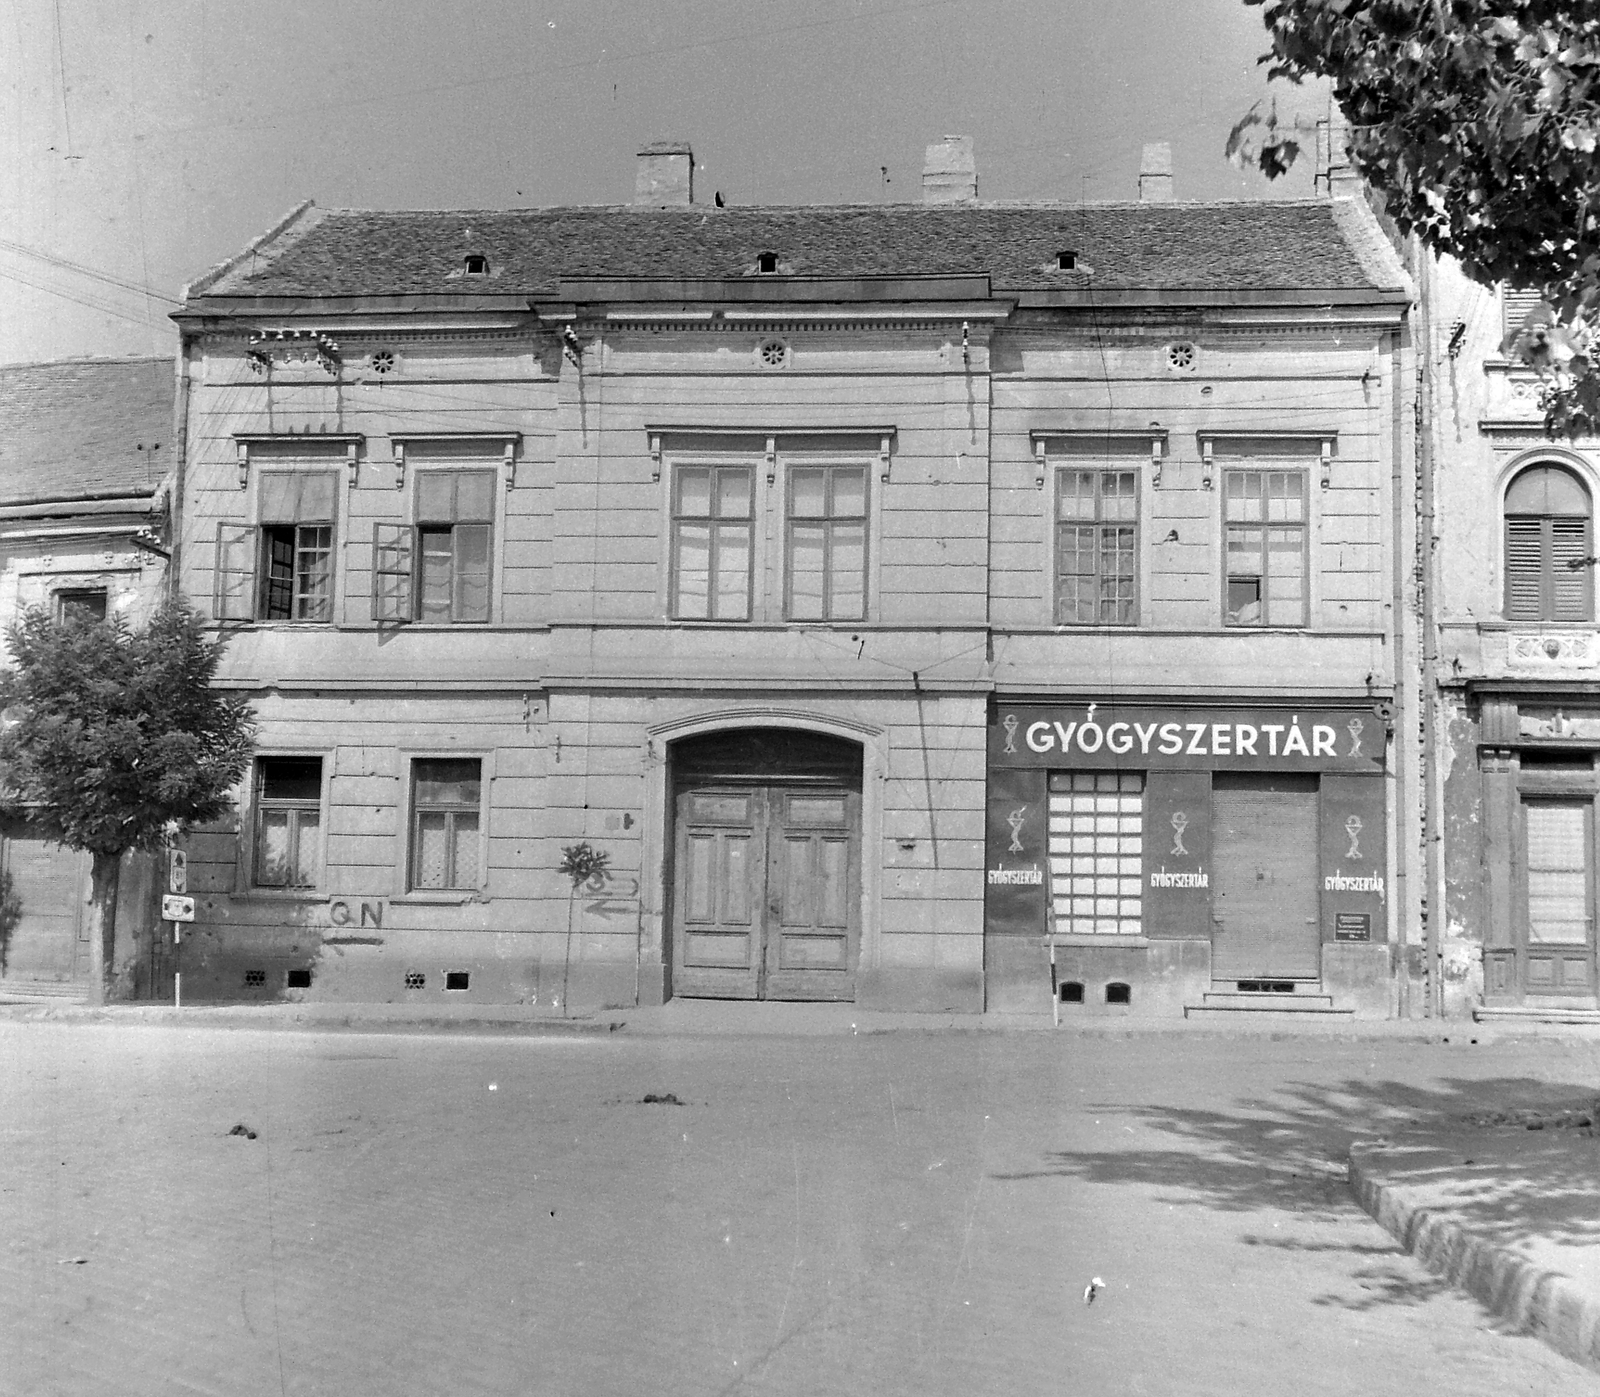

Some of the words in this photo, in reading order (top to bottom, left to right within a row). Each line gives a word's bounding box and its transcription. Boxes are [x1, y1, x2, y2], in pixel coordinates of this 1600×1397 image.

[1026, 713, 1337, 757] GYÓGYSZERTÁR
[988, 863, 1043, 885] GYÓGYSZERTÁR
[1151, 866, 1209, 888] GYÓGYSZERTÁR
[1325, 869, 1385, 891] GYÓGYSZERTÁR
